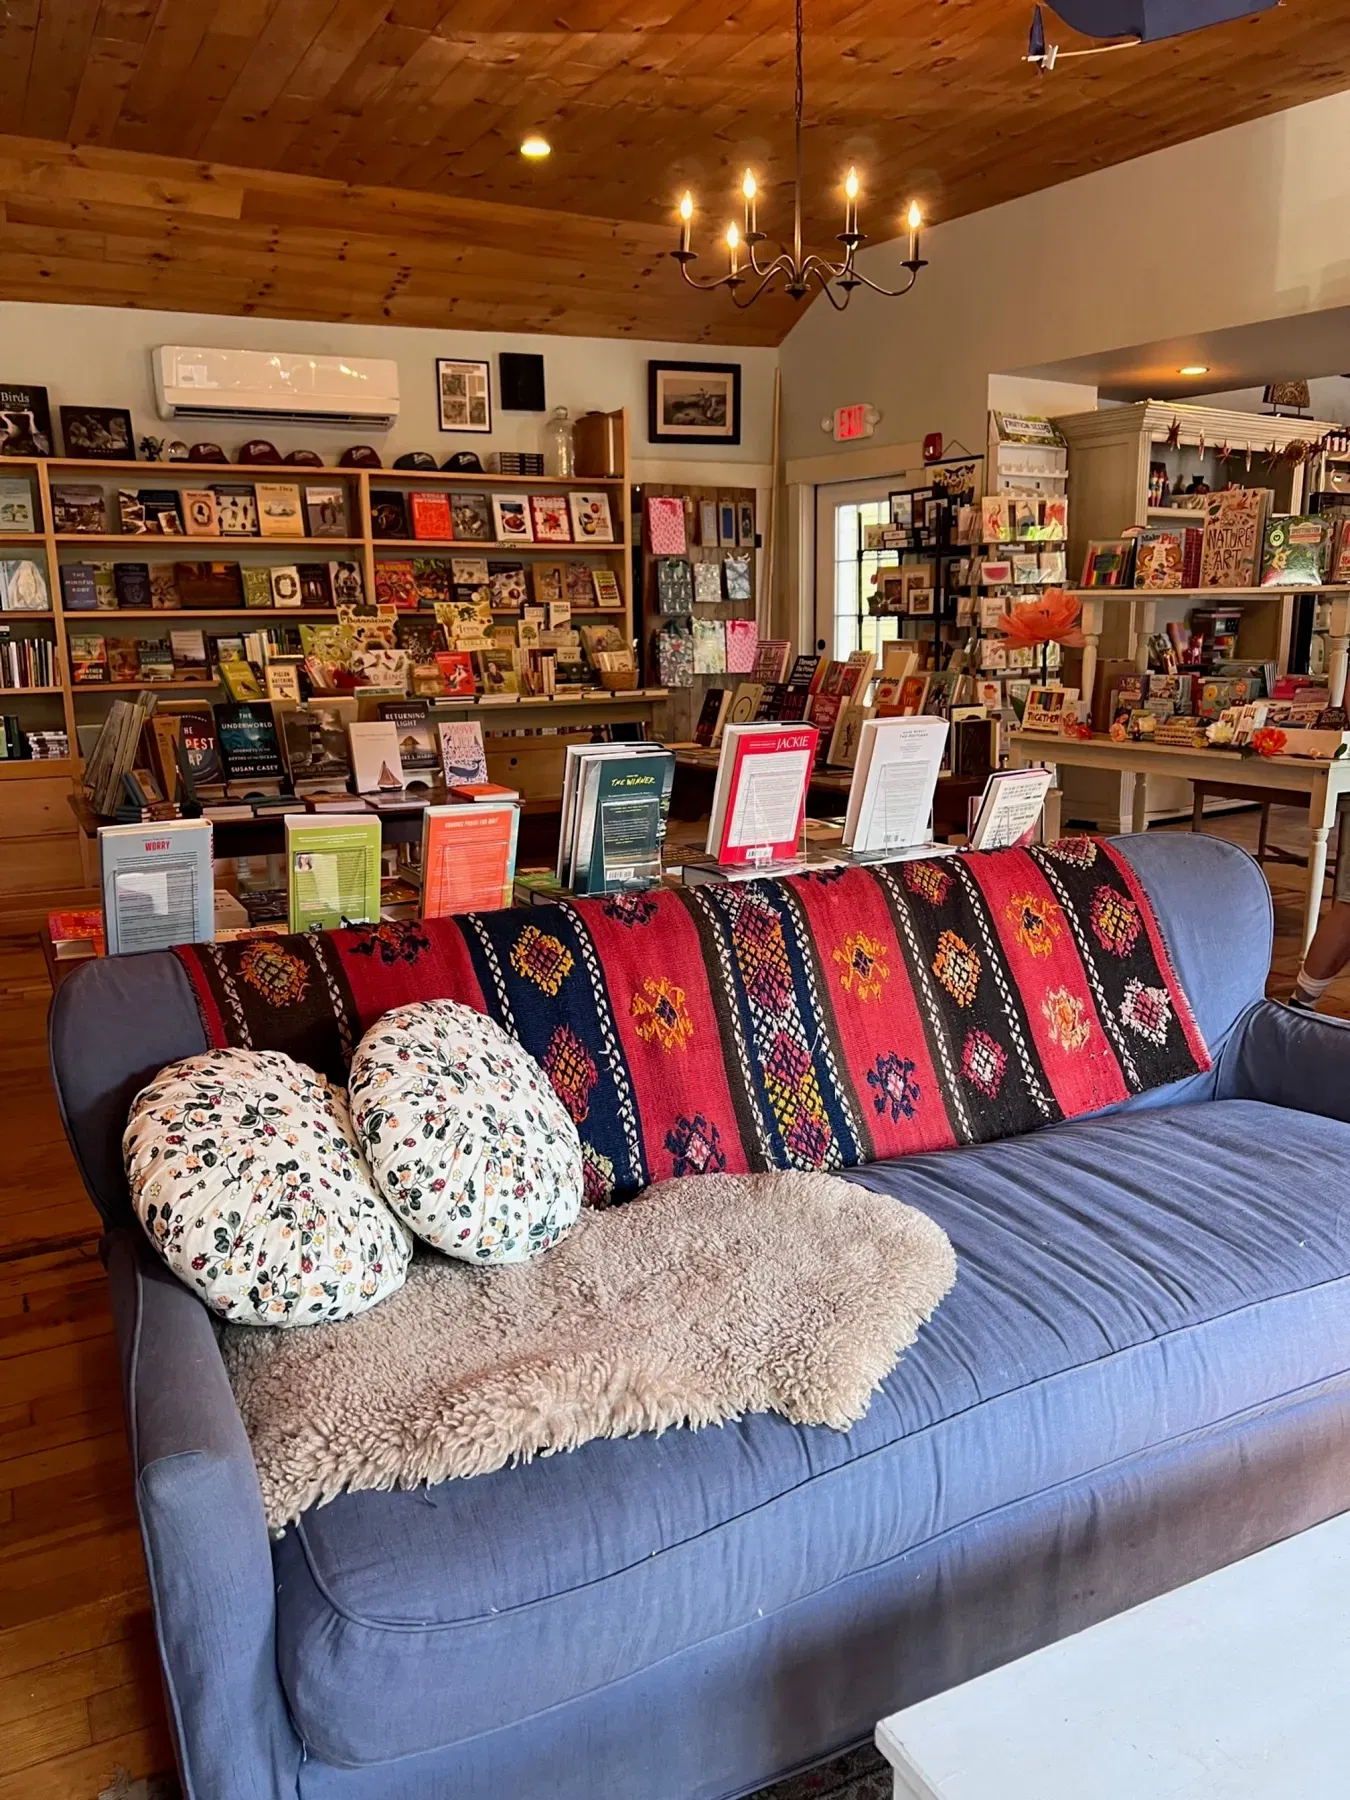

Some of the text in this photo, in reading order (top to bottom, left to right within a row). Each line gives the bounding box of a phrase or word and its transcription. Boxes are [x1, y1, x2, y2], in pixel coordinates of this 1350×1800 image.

[1, 392, 30, 403] Birds
[839, 405, 863, 438] EXIT
[1004, 419, 1050, 433] FRUITION SEEDS
[1209, 527, 1252, 549] NATURE
[1213, 549, 1242, 570] ART
[460, 624, 480, 632] Trees
[385, 712, 426, 720] RETURNING
[1027, 711, 1061, 723] TOGETHER
[221, 722, 273, 730] UNDERWORLD
[396, 720, 417, 728] LIGHT
[183, 726, 193, 734] HE
[775, 735, 810, 751] JACKIE
[188, 753, 203, 766] AP
[611, 779, 625, 787] THE
[626, 776, 656, 787] WINNER
[145, 841, 170, 851] WORRY
